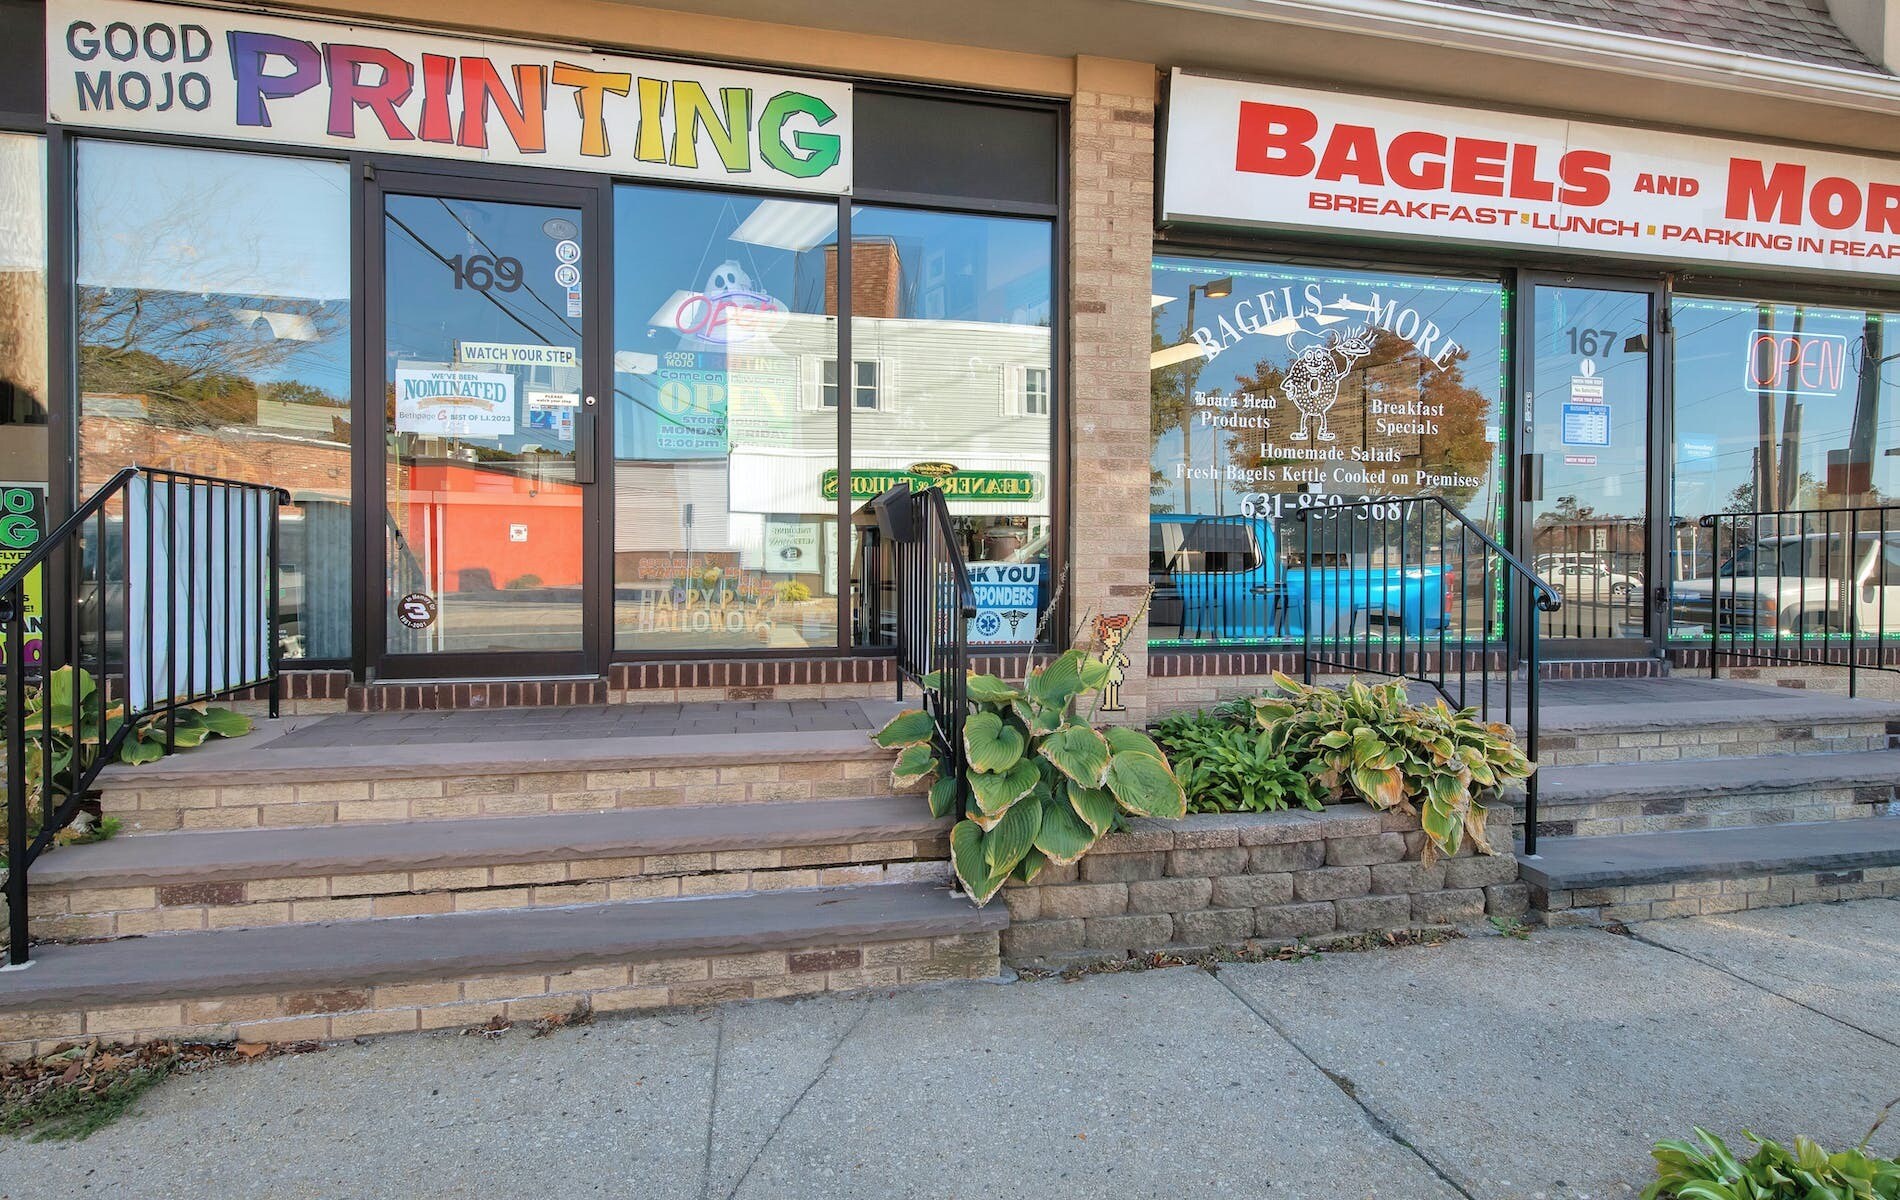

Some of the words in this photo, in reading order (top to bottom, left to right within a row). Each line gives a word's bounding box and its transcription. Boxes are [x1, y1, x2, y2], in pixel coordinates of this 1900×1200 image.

[65, 20, 213, 64] GOOD
[75, 70, 212, 112] MOJO
[226, 29, 842, 179] PRINTING
[1236, 100, 1611, 207] BAGELS
[1634, 171, 1700, 198] AND
[1309, 191, 1518, 226] BREAKFAST
[1531, 212, 1639, 239] LUNCH
[1662, 225, 1793, 252] PARKING
[1798, 237, 1824, 254] IN
[447, 254, 523, 293] 169
[1191, 284, 1323, 363] BAGELS
[1364, 292, 1461, 373] MORE
[1566, 326, 1617, 358] 167
[465, 347, 508, 360] WATCH
[512, 349, 542, 361] YOUR
[546, 351, 572, 363] STEP
[664, 352, 695, 360] GOOD
[1751, 336, 1842, 389] OPEN
[404, 379, 507, 403] NOMINATED
[1195, 391, 1238, 407] Boar's
[1242, 392, 1277, 409] Head
[400, 411, 436, 421] Bethpage
[1371, 399, 1444, 417] Breakfast
[683, 416, 724, 424] STORE
[1201, 411, 1271, 429] Products
[1376, 418, 1439, 436] Specials
[661, 426, 724, 436] MONDAY
[1260, 443, 1344, 461] Homemade
[1351, 446, 1401, 463] Salads
[1175, 464, 1218, 480] Fresh
[1226, 465, 1276, 483] Bagels
[1282, 466, 1327, 483] Kettle
[1333, 468, 1385, 484] Cooked
[1392, 473, 1408, 485] on
[1416, 470, 1479, 488] Premises
[995, 566, 1036, 582] YOU
[974, 586, 1034, 605] SPONDERS
[404, 602, 430, 620] 3
